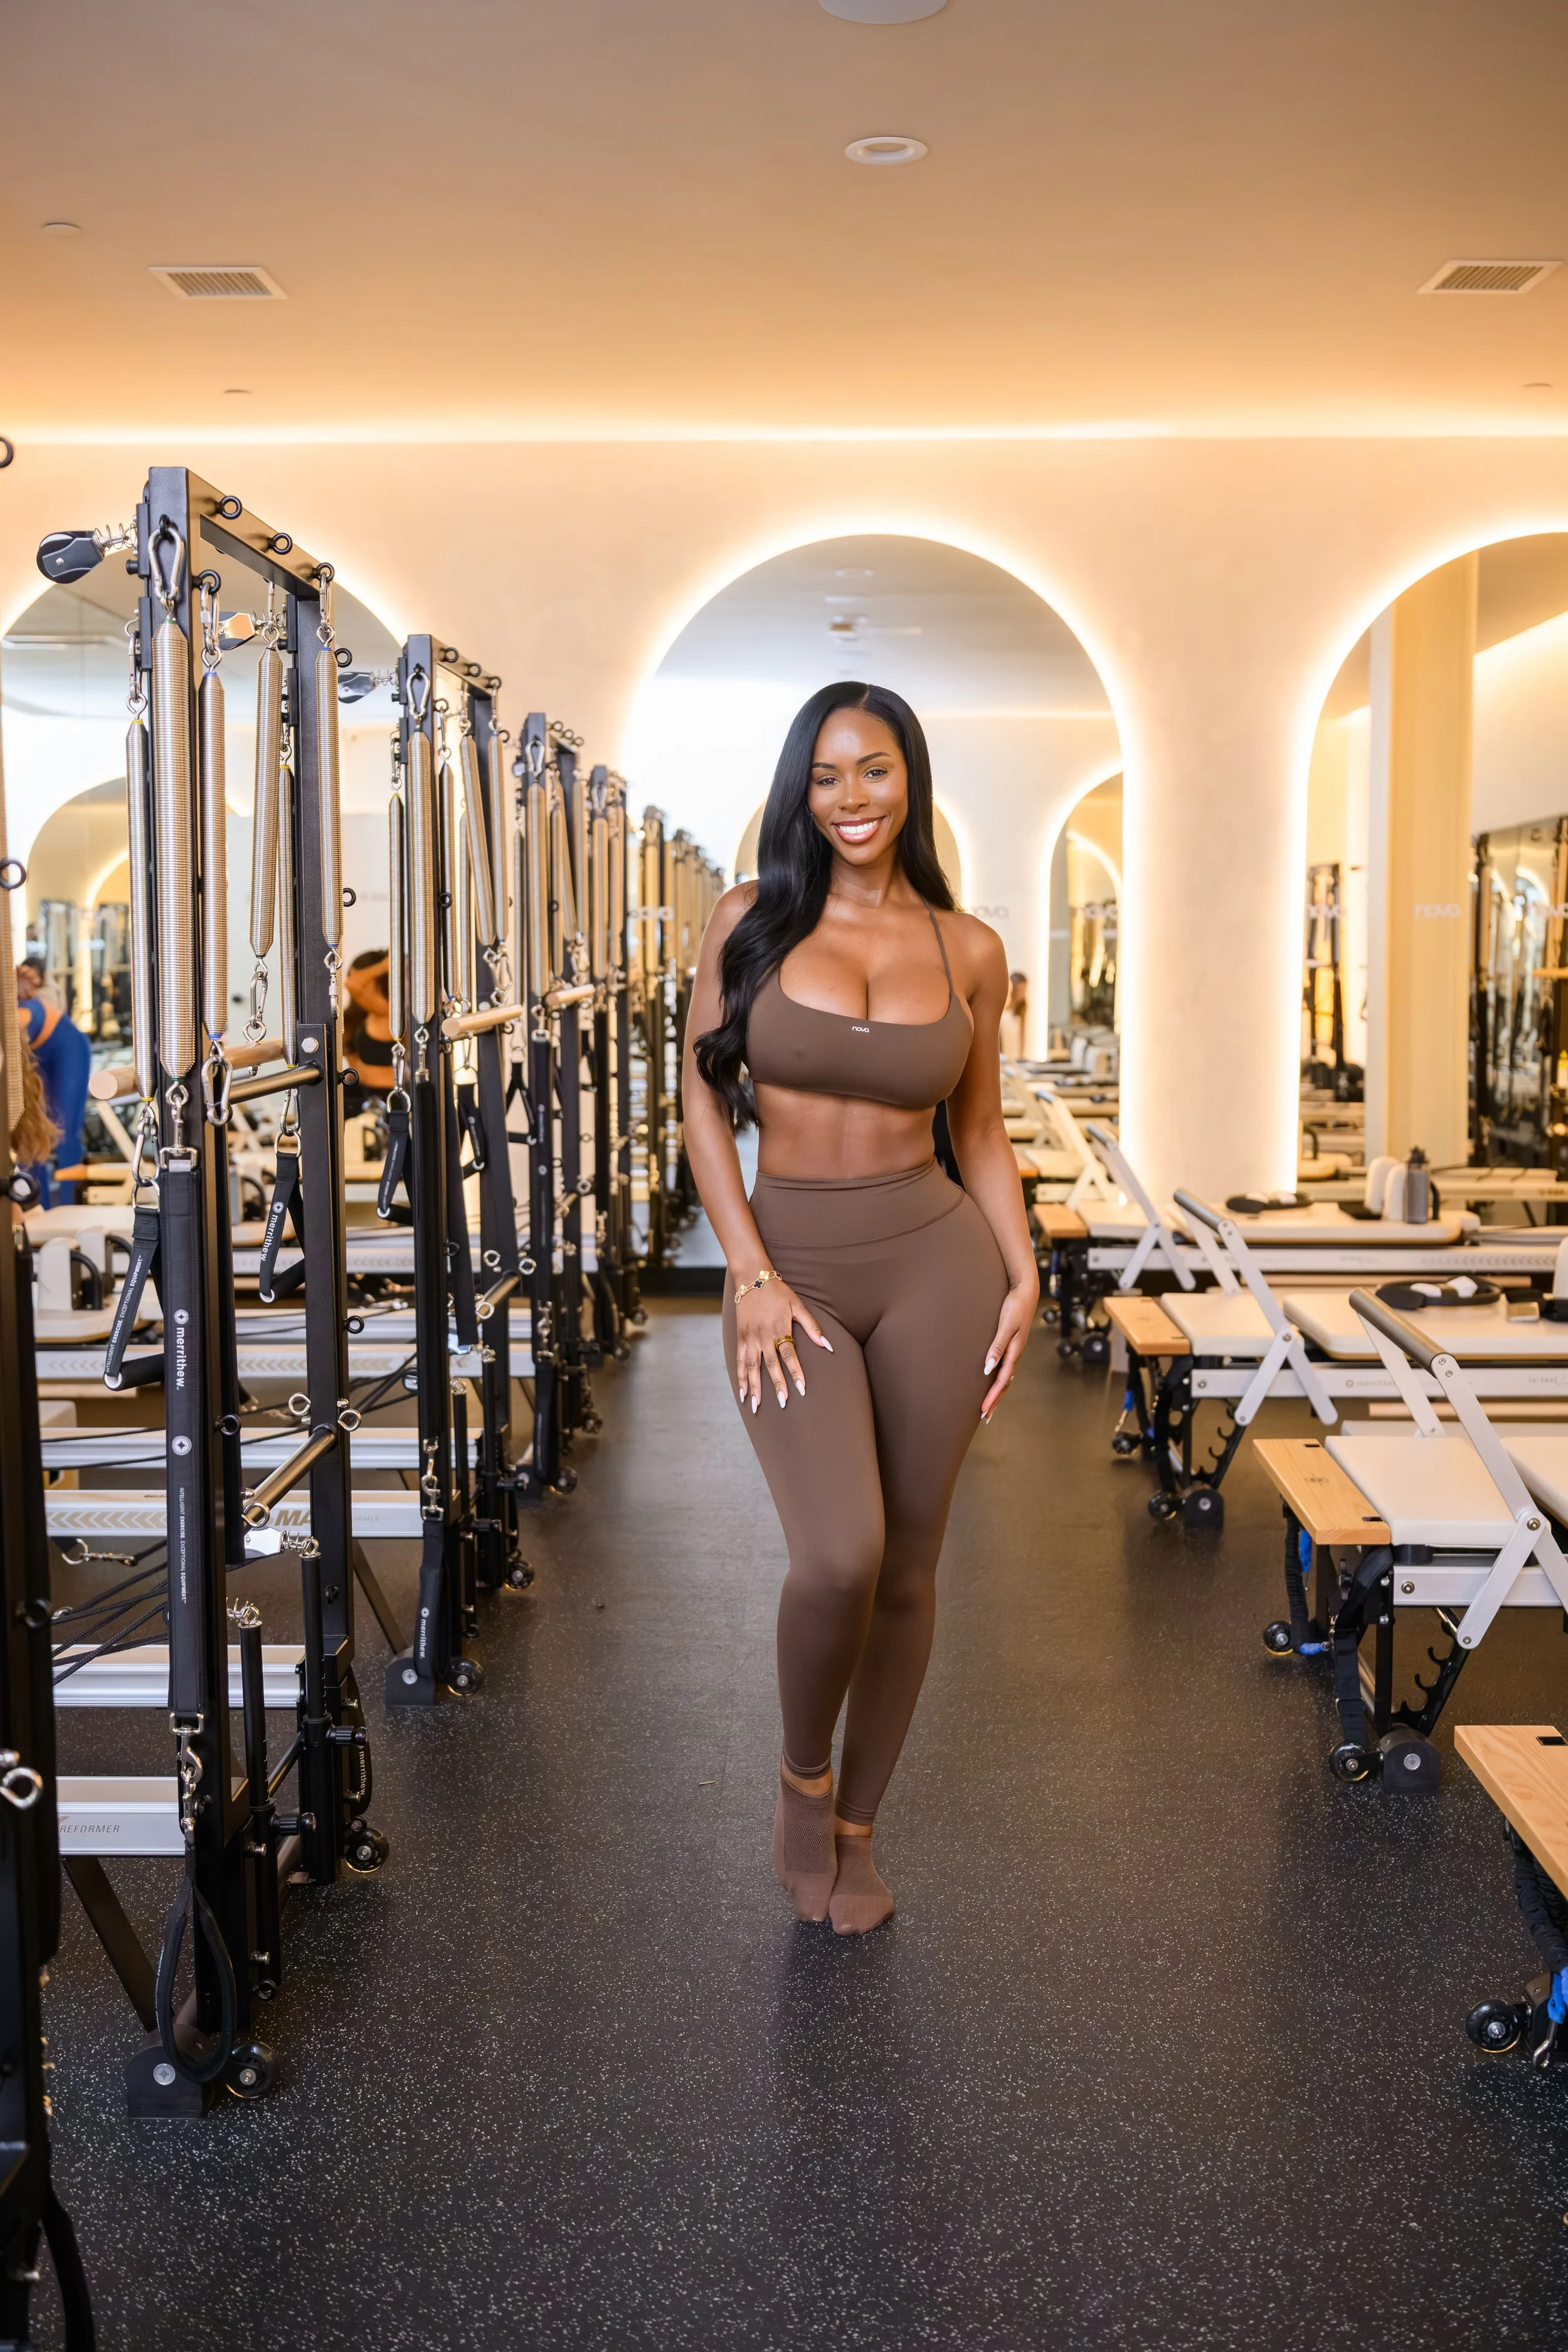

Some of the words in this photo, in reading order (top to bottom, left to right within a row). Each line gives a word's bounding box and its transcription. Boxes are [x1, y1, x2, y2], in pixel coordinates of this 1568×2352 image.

[261, 1214, 278, 1261] merrithew
[105, 1344, 115, 1373] INTELLIGENT
[119, 1288, 134, 1318] EXCEPTIONAL
[60, 1825, 120, 1833] REFORMER
